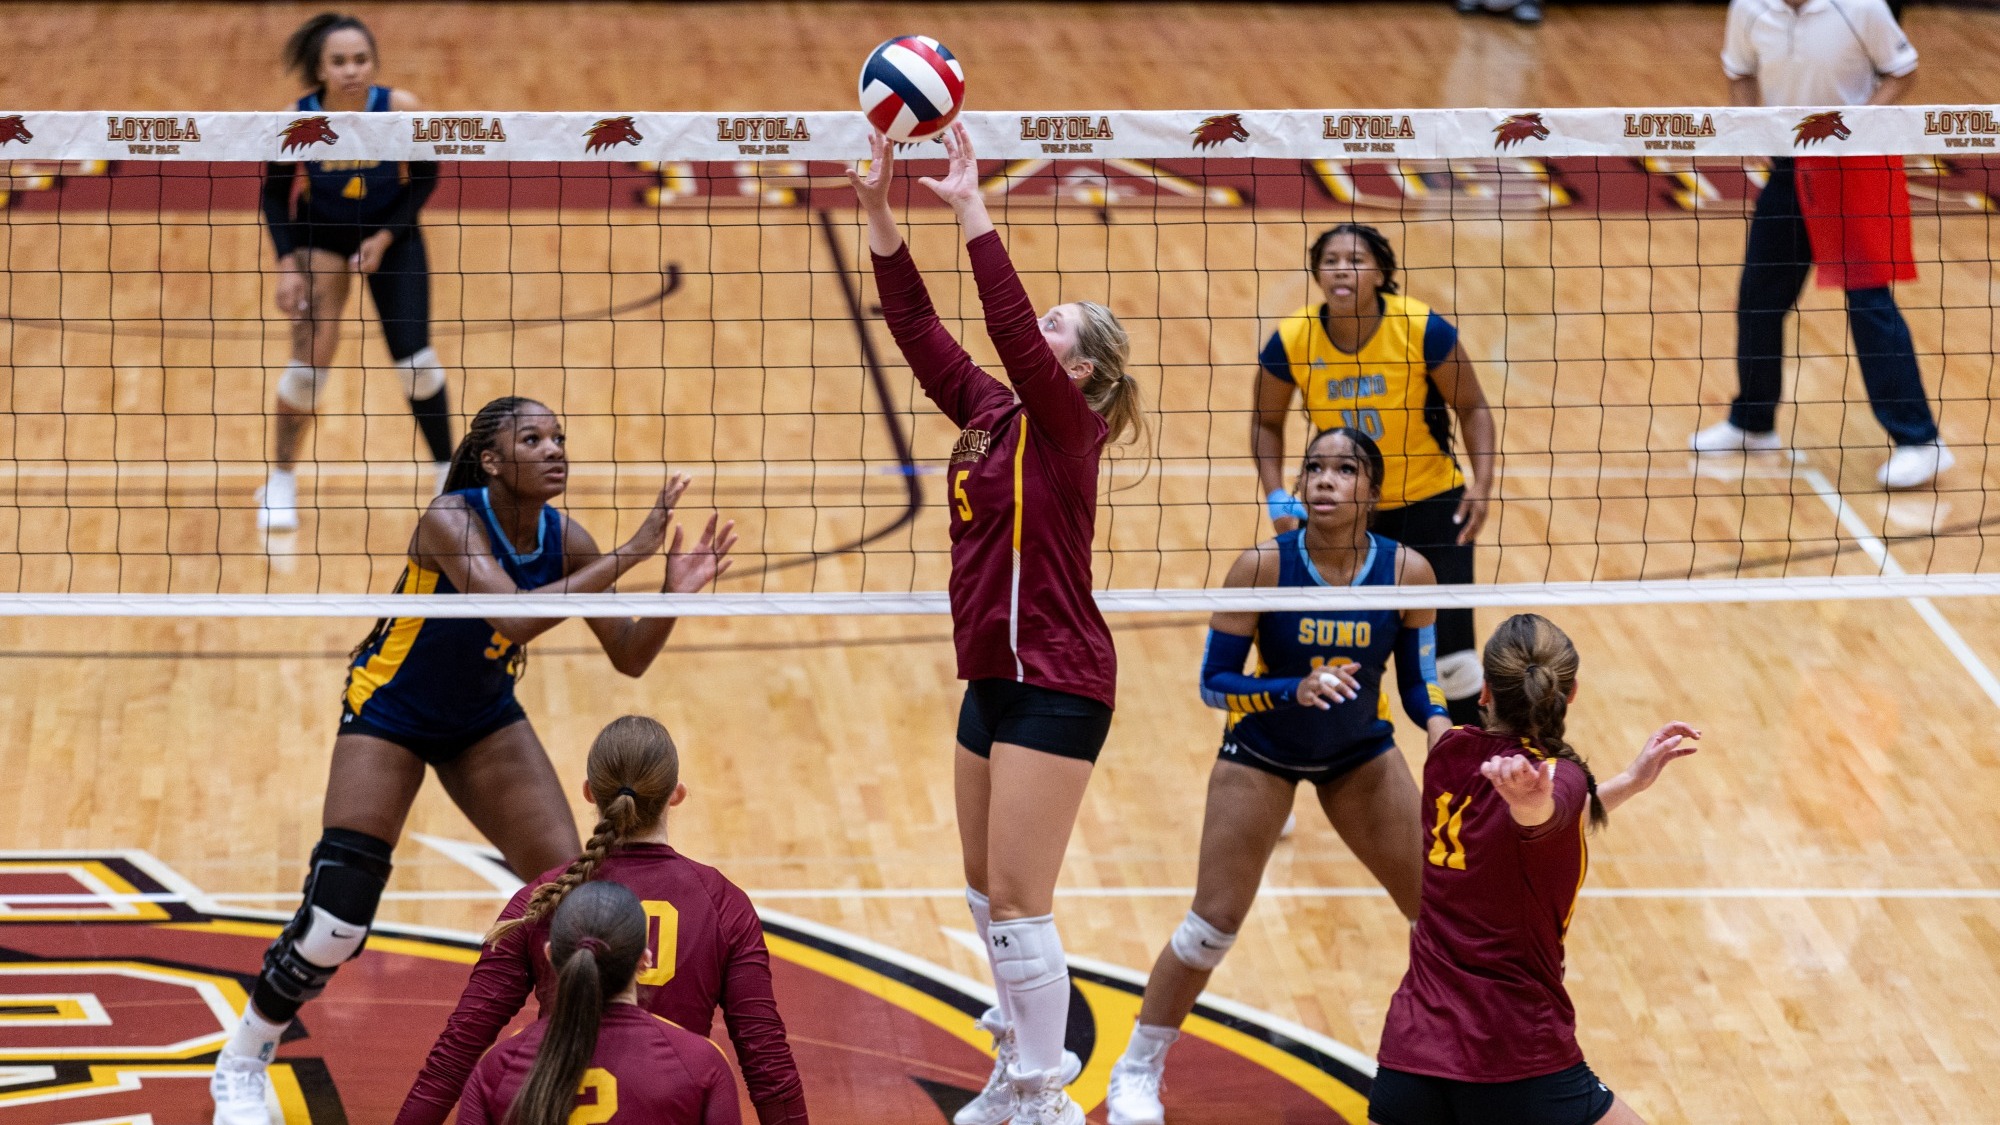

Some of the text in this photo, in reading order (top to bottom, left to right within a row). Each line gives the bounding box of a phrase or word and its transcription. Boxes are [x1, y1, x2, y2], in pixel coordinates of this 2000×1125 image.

[108, 117, 200, 142] LOYOLA
[412, 118, 506, 142] LOYOLA
[717, 118, 810, 141] LOYOLA
[1021, 116, 1113, 140] LOYOLA
[1323, 115, 1415, 139] LOYOLA
[1624, 114, 1716, 138] LOYOLA
[1924, 110, 2000, 136] LOYOL
[128, 144, 180, 155] WOLF PACK
[434, 145, 485, 155] WOLF PACK
[738, 144, 789, 155] WOLF PACK
[1041, 143, 1093, 153] WOLF PACK
[1344, 142, 1395, 153] WOLF PACK
[1645, 140, 1696, 150] WOLF PACK
[1944, 137, 1996, 148] WOLF PACK
[1327, 374, 1387, 400] SUNO
[954, 470, 973, 522] 5
[1298, 617, 1371, 648] SUNO
[1428, 791, 1473, 871] 11
